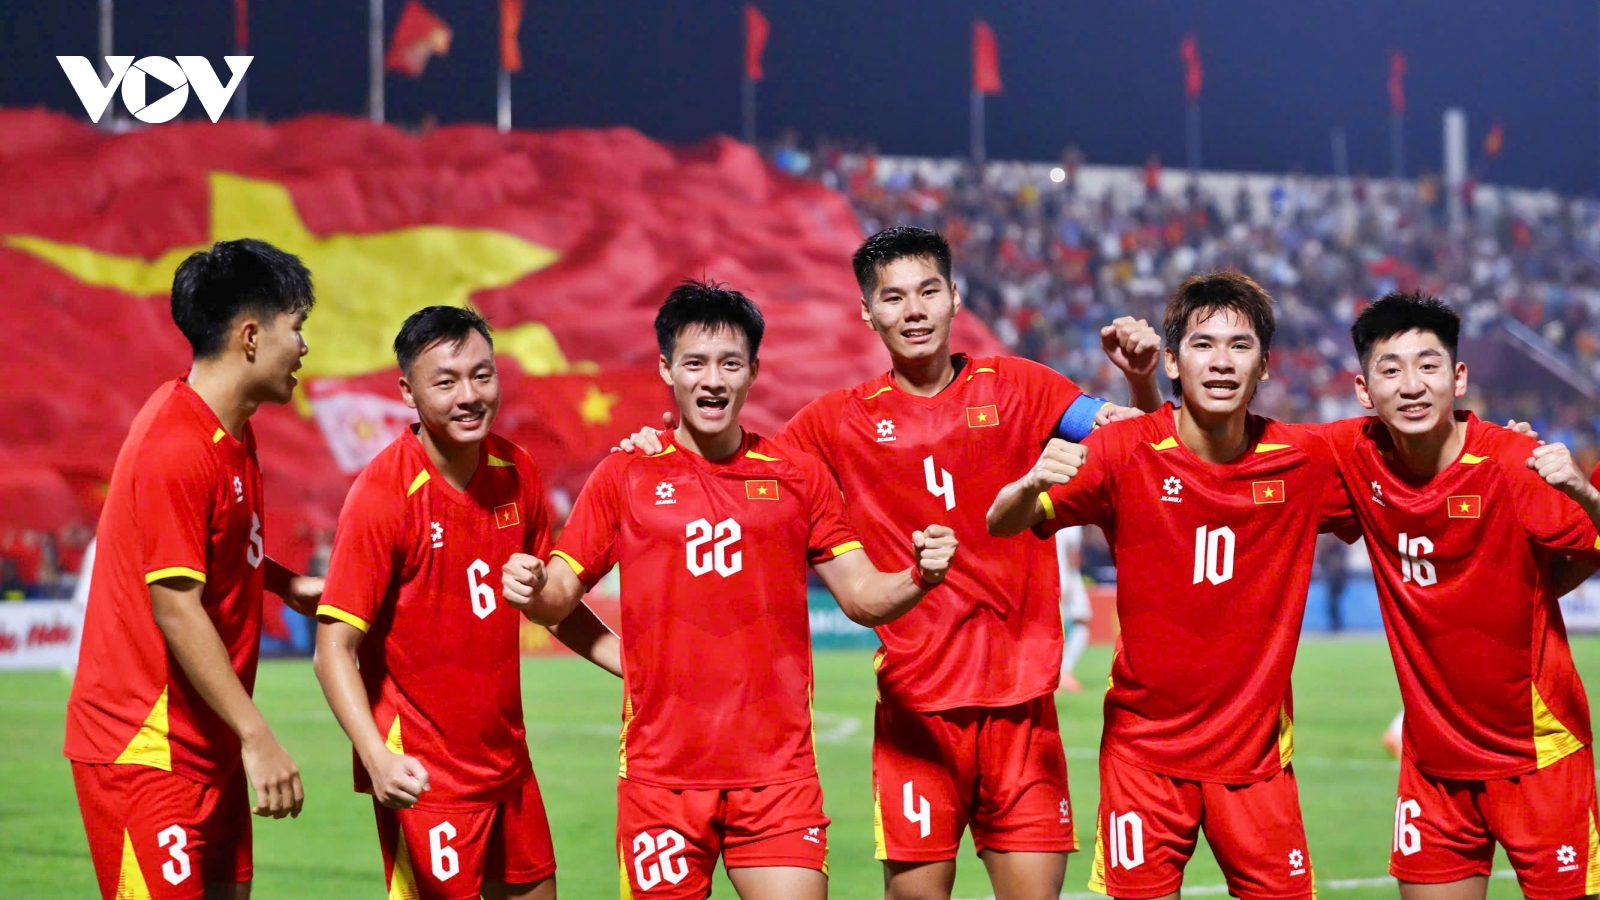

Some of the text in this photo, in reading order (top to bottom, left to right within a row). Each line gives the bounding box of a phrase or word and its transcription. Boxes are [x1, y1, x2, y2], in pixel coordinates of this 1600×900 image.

[924, 455, 955, 511] 4
[686, 518, 742, 577] 22
[1193, 525, 1235, 585] 10
[1399, 533, 1437, 586] 16
[467, 559, 496, 619] 6
[903, 781, 930, 838] 4
[1394, 797, 1421, 855] 16
[158, 825, 190, 885] 3
[429, 821, 459, 881] 6
[633, 829, 689, 891] 22
[1110, 811, 1144, 870] 10
